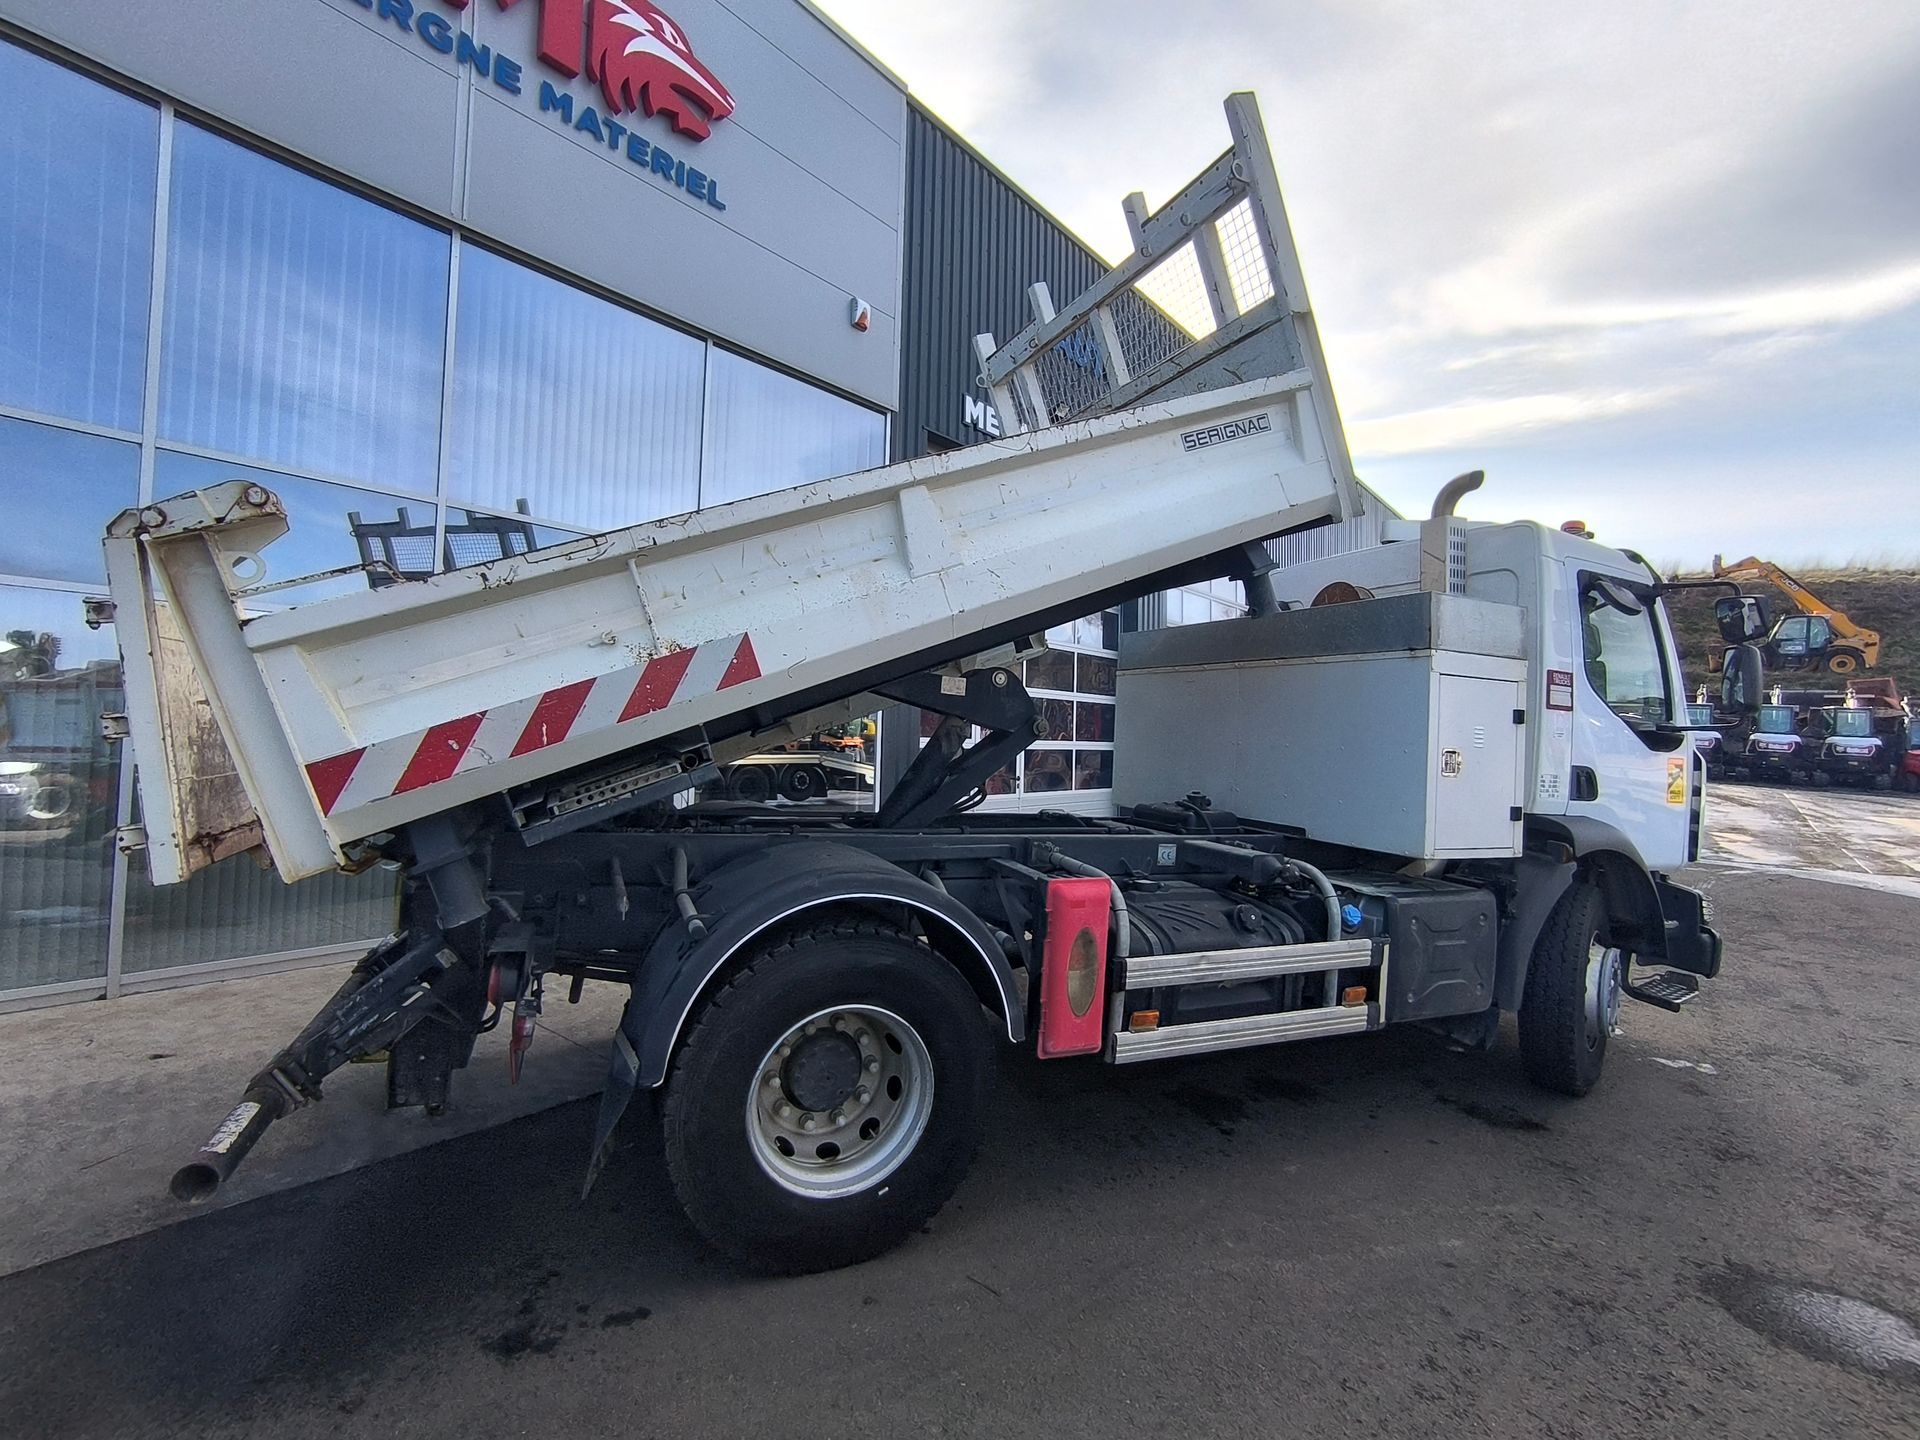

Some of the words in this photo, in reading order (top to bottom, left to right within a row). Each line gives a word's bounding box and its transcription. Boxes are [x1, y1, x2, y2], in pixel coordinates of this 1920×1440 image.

[351, 0, 522, 95] RGNE
[540, 80, 726, 211] MATERIEL
[1184, 416, 1269, 449] SERIGNAC
[1781, 577, 1801, 592] JCB
